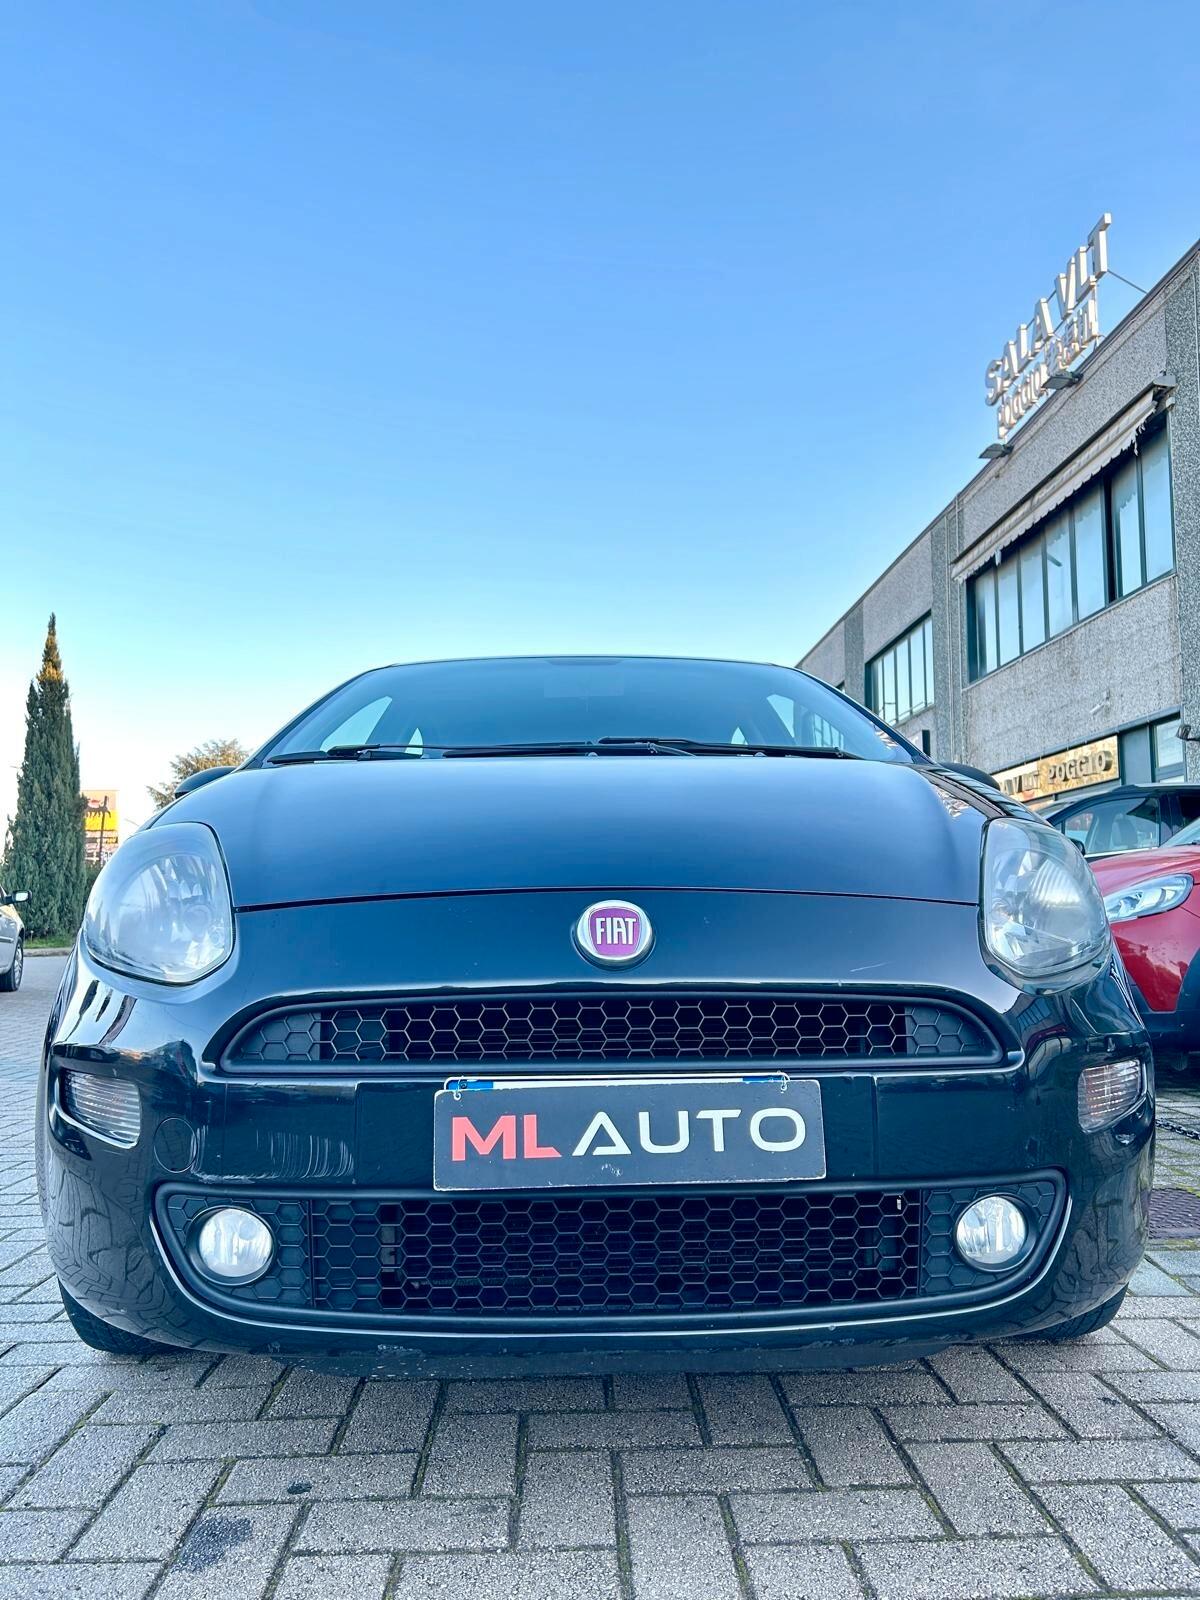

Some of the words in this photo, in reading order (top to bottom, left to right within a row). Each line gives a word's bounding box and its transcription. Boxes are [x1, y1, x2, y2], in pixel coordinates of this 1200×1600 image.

[985, 297, 1055, 406] SALA
[1054, 213, 1112, 321] VLT
[1048, 750, 1113, 785] POGGIO
[595, 916, 637, 945] FIAT
[451, 1114, 562, 1161] ML
[572, 1107, 806, 1156] AUTO
